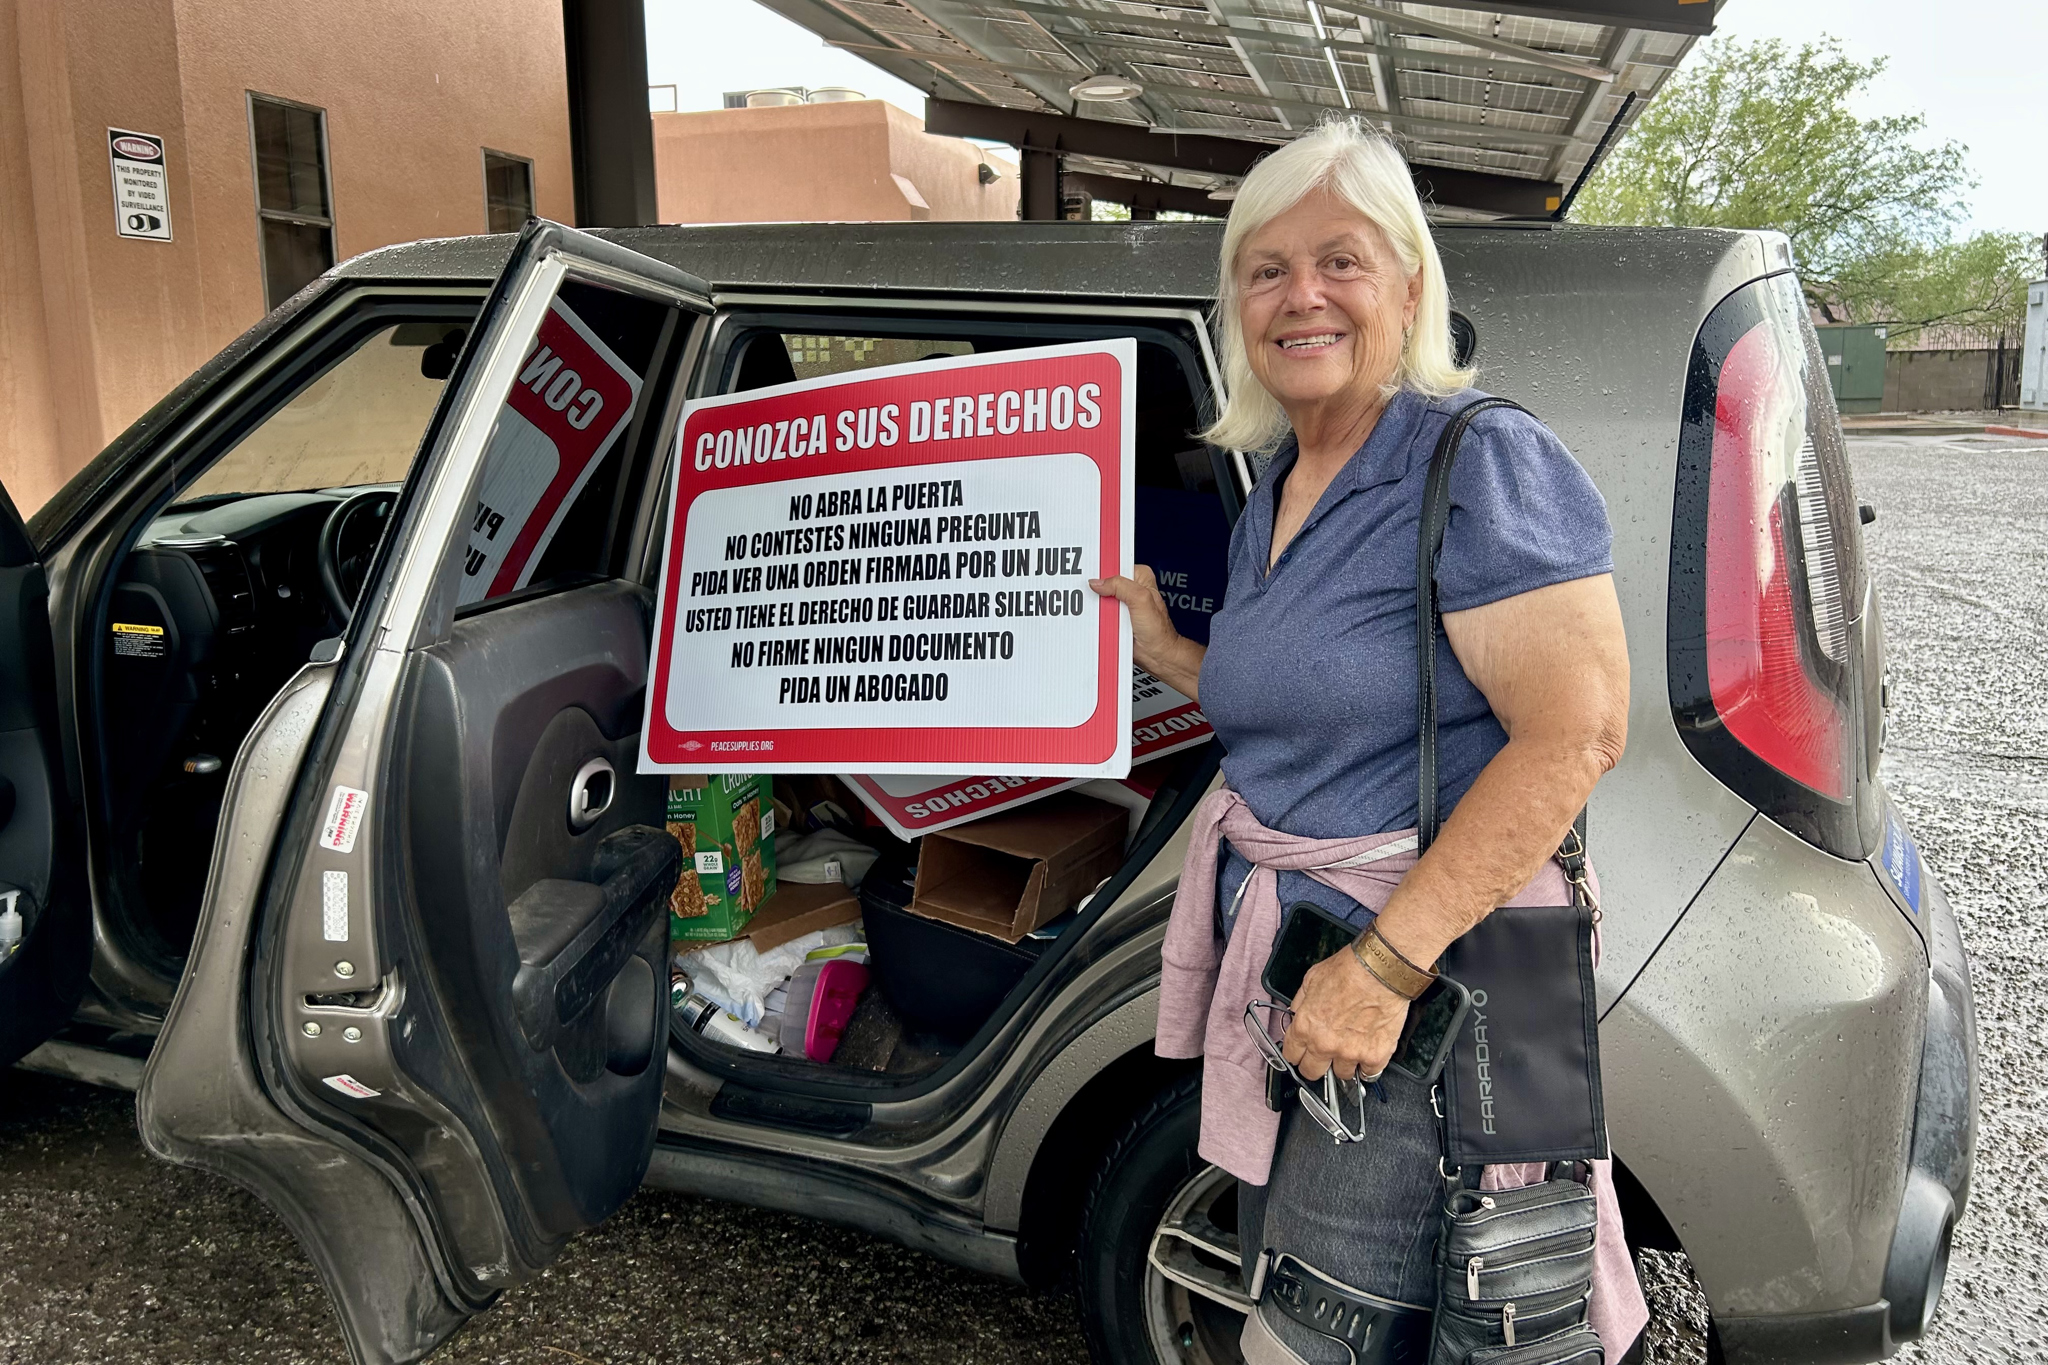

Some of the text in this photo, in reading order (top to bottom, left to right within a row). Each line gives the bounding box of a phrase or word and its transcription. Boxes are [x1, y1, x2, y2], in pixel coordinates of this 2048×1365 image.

[120, 142, 154, 155] WARNING
[116, 165, 162, 178] THIS PROPERTY
[123, 178, 157, 189] MONITORED
[121, 201, 164, 212] SURVEILLANCE
[138, 191, 156, 200] VIDEO
[694, 382, 1102, 472] CONOZCA SUS DERECHOS
[789, 479, 963, 521] NO ABRA LA PUERTA
[724, 511, 1041, 561] NO CONTESTES NINGUNA PREGUNTA
[690, 547, 1083, 597] PIDA VER UNA ORDEN FIRMADA POR UN JUEZ
[1160, 570, 1188, 588] WE
[685, 589, 1084, 633] USTED TIENE EL DERECHO DE GUARDAR SILENCIO
[730, 631, 1014, 668] NO FIRME NINGUN DOCUMENTO
[778, 673, 949, 704] PIDA UN ABOGADO
[710, 740, 774, 752] PEACESUPPLIES.ORG
[903, 776, 1034, 820] RECHOS
[332, 793, 356, 846] WARNING
